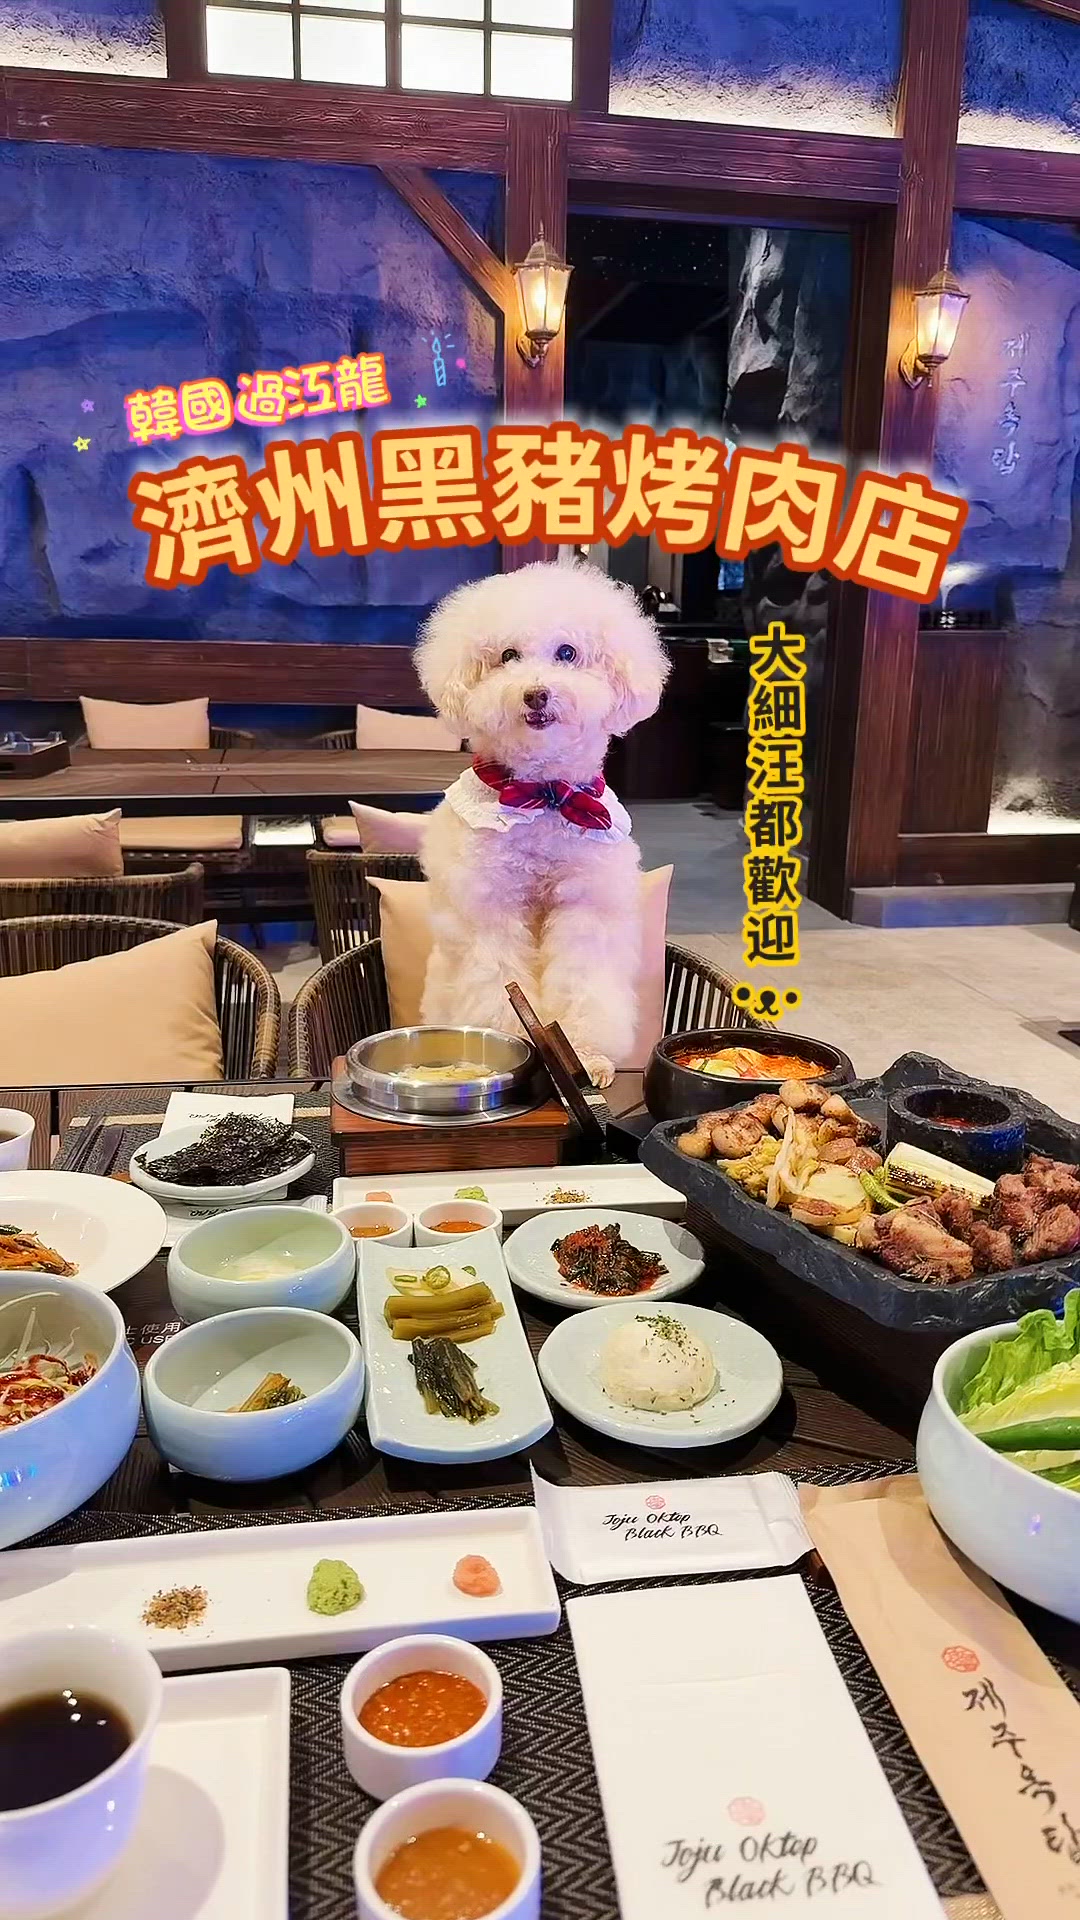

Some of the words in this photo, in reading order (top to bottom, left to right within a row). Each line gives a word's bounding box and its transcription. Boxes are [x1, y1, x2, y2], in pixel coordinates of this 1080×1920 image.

[624, 1525, 676, 1541] Black
[680, 1523, 723, 1539] BBQ
[704, 1868, 796, 1909] Black
[806, 1860, 883, 1898] BBQ
